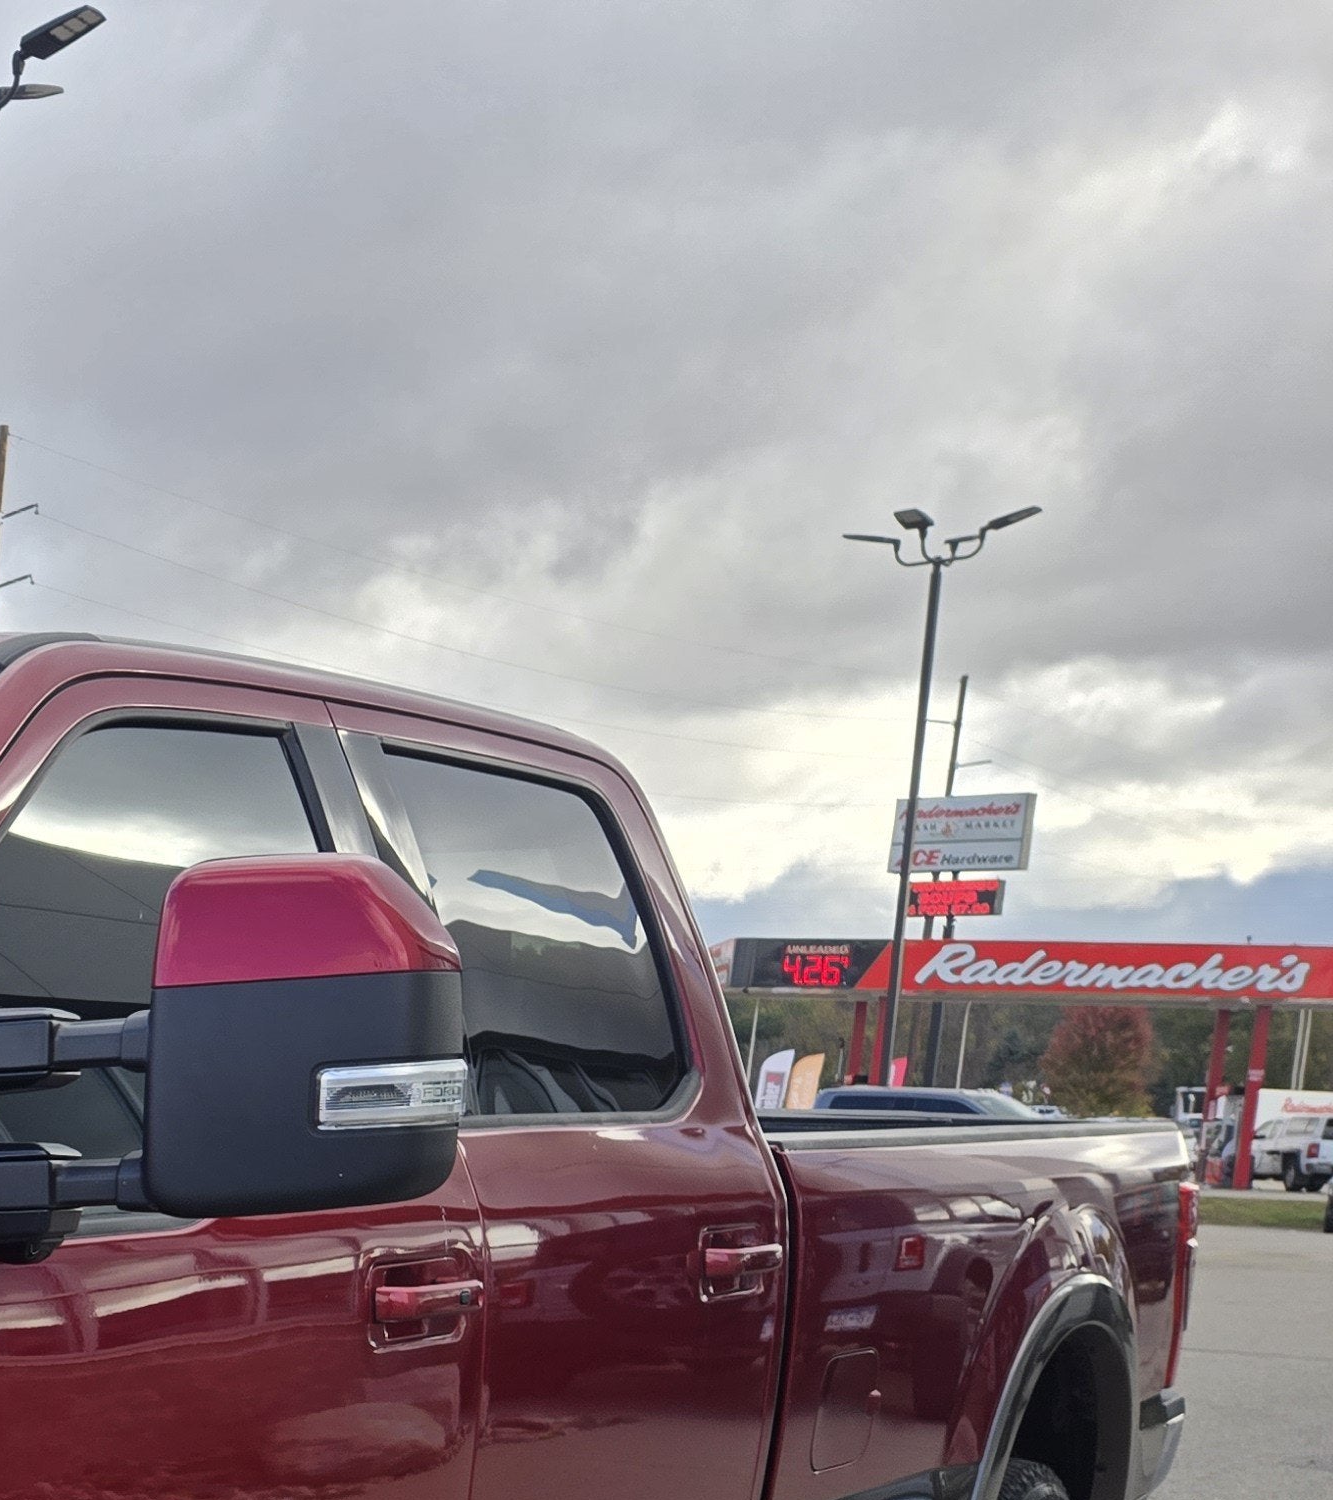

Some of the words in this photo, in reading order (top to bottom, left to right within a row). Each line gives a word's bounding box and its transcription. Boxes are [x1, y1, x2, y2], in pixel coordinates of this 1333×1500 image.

[940, 853, 1015, 866] Hardware
[786, 944, 850, 955] UNLEADED
[914, 943, 1311, 992] Radermacher's
